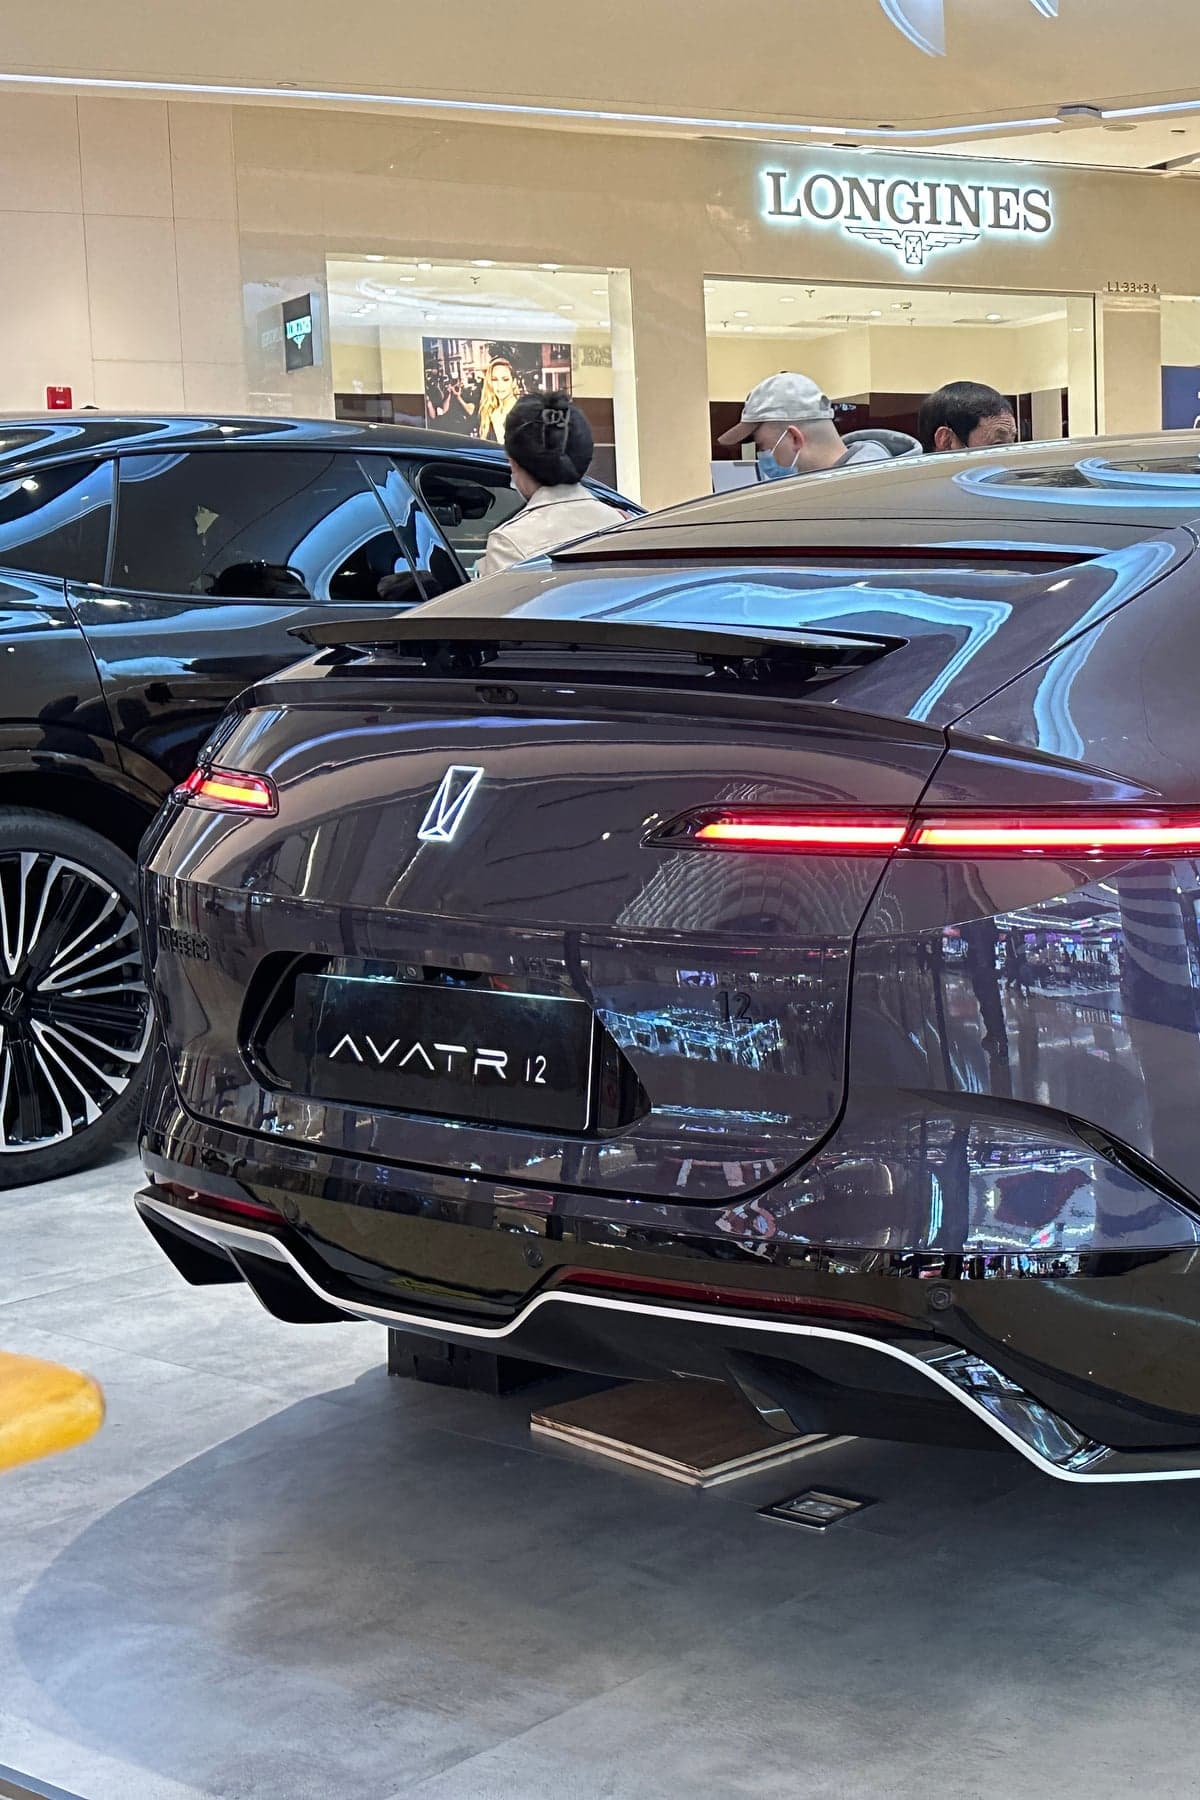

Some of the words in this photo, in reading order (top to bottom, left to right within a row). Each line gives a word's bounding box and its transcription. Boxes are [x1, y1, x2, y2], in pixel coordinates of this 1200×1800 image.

[766, 171, 1051, 233] LONGINES
[1107, 281, 1157, 294] L1-33+34
[715, 991, 753, 1024] 12
[329, 1034, 508, 1079] AVATR
[525, 1055, 547, 1084] 12
